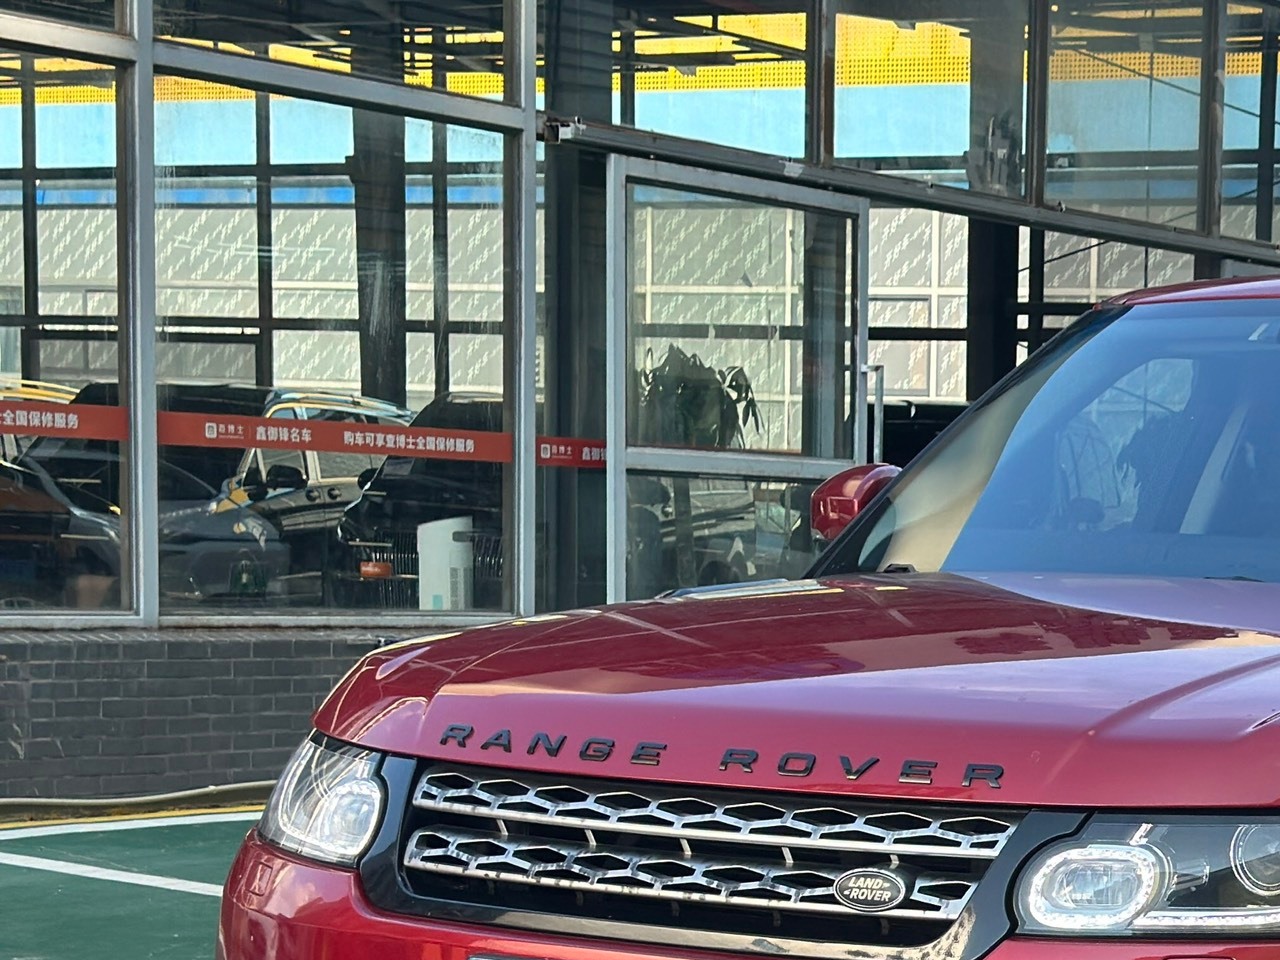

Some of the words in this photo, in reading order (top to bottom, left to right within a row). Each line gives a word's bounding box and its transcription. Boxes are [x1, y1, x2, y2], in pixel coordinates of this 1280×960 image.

[0, 409, 78, 429] 全国保修服务
[343, 431, 475, 453] 购车可享查博士全国保修服务
[440, 724, 667, 766] RANGE
[719, 748, 1005, 789] ROVER
[848, 876, 884, 889] LAND
[849, 888, 892, 902] ROVER
